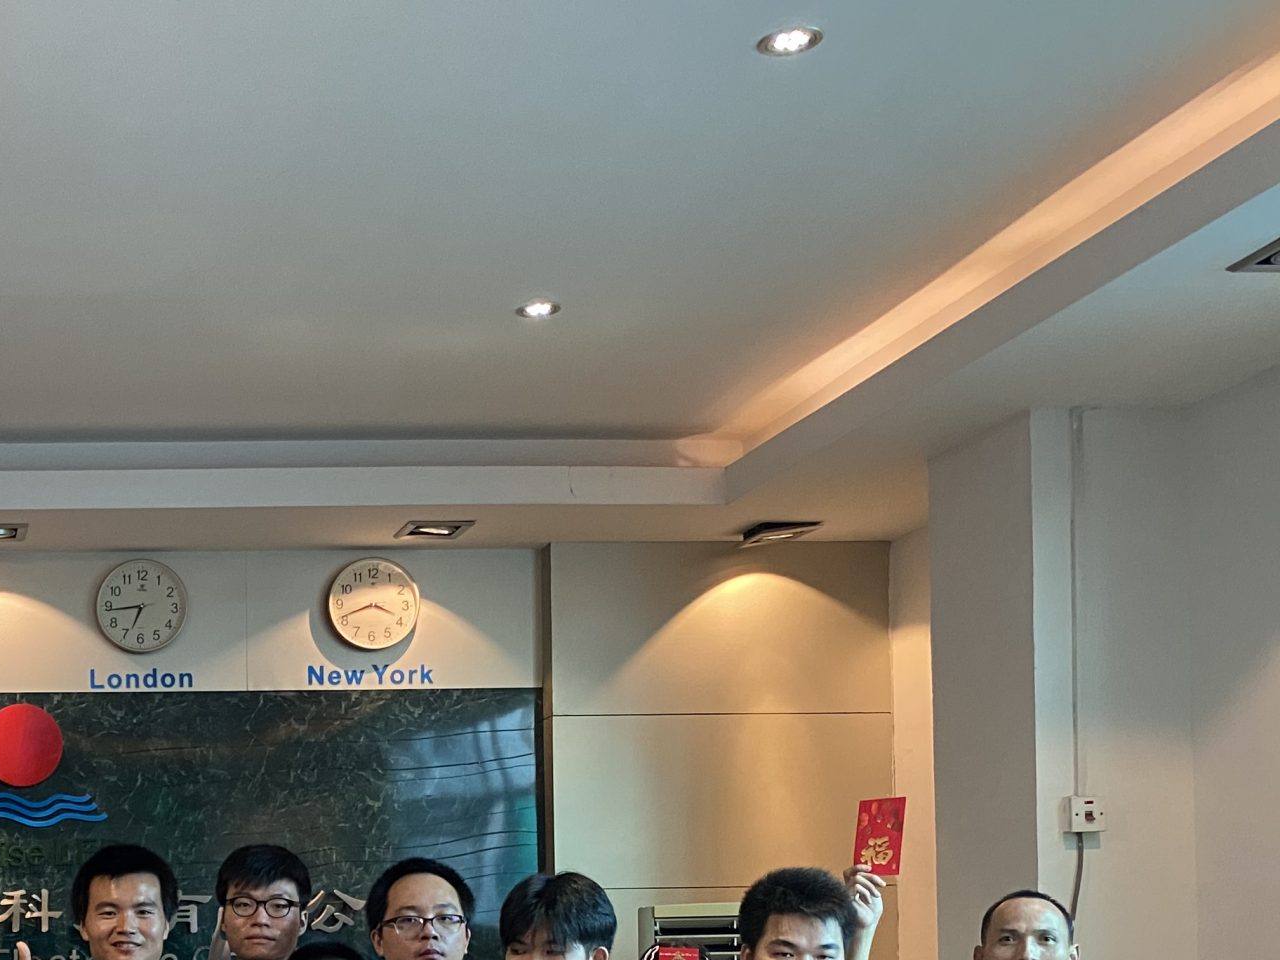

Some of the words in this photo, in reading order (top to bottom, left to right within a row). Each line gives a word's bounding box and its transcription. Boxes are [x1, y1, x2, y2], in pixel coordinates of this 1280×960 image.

[137, 570, 148, 581] 12
[354, 572, 362, 583] 11
[368, 568, 379, 579] 12
[388, 572, 391, 583] 1
[122, 574, 131, 585] 11
[156, 575, 161, 586] 1
[110, 586, 121, 597] 10
[166, 586, 174, 598] 2
[341, 584, 352, 594] 10
[397, 584, 404, 595] 2
[104, 600, 113, 612] 9
[170, 602, 178, 614] 3
[335, 598, 344, 610] 9
[401, 600, 409, 611] 3
[110, 617, 118, 628] 8
[165, 619, 172, 630] 4
[341, 615, 348, 626] 8
[395, 616, 403, 627] 4
[121, 628, 129, 639] 7
[152, 629, 161, 641] 5
[353, 626, 360, 637] 7
[368, 630, 376, 642] 6
[384, 627, 391, 638] 5
[136, 633, 145, 644] 6
[89, 668, 194, 689] London
[307, 665, 364, 686] New
[372, 664, 434, 685] York
